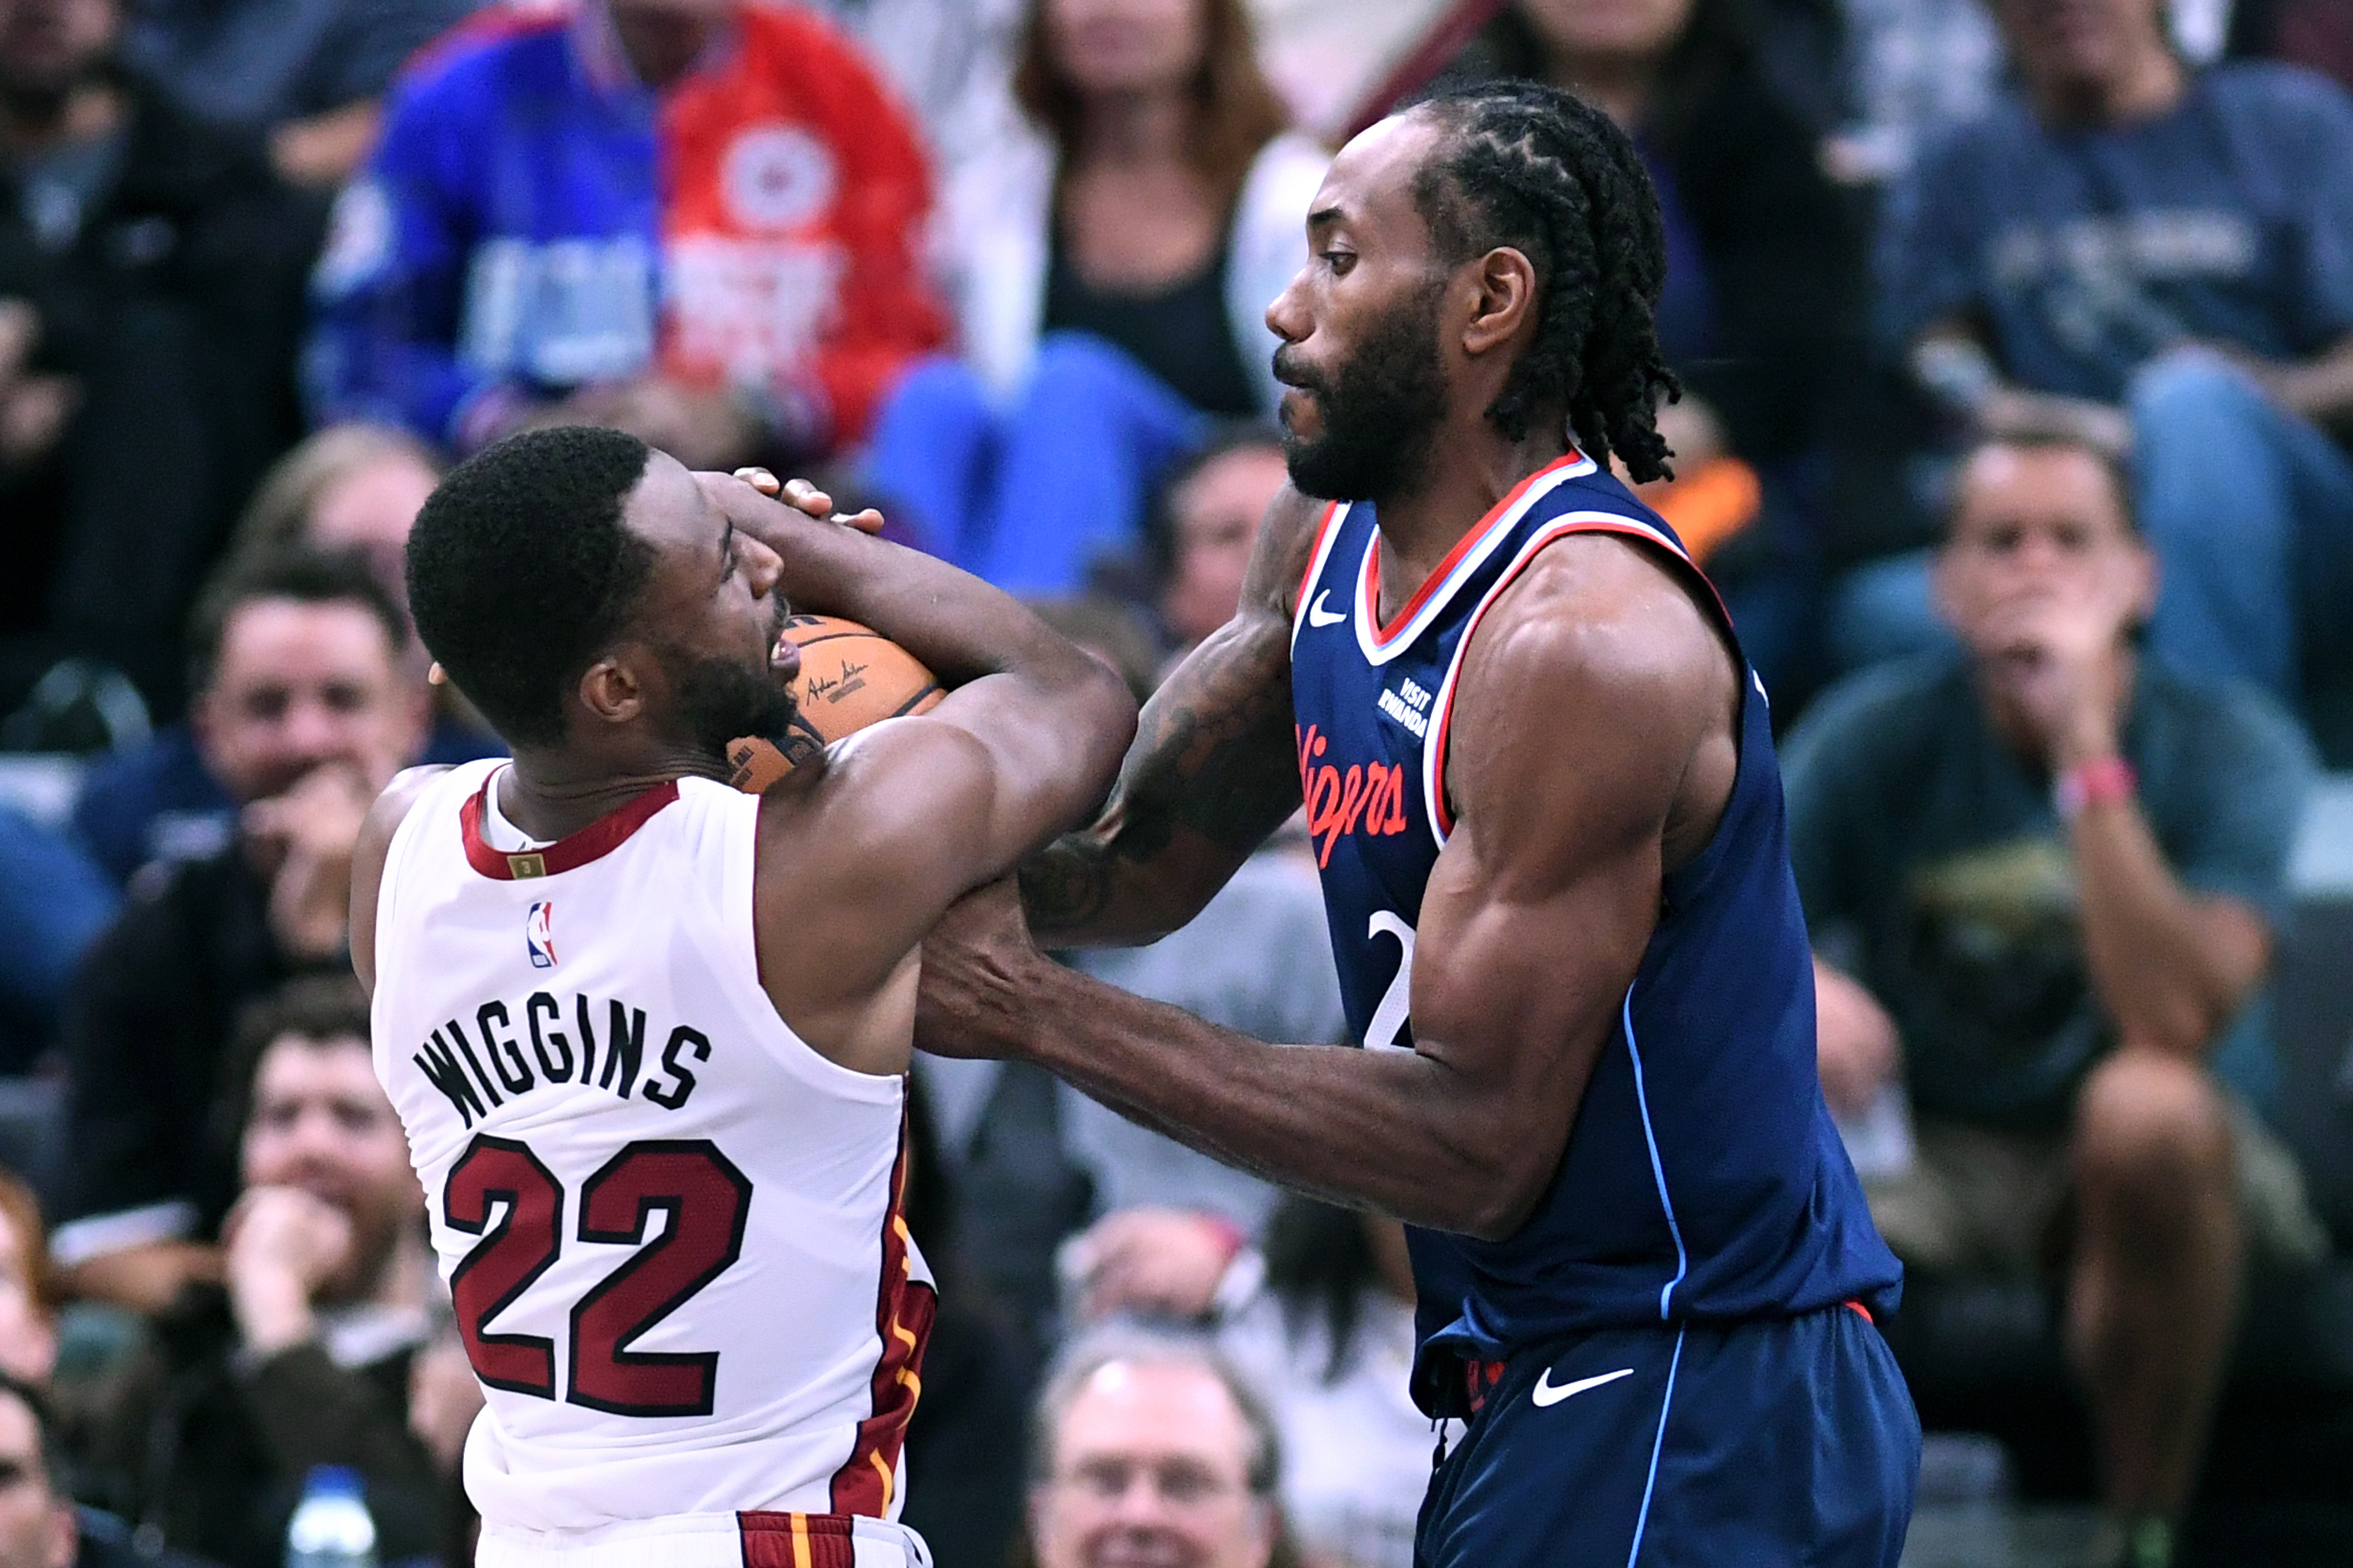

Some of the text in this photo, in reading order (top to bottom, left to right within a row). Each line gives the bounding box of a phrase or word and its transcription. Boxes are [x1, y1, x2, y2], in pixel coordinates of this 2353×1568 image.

[1377, 688, 1428, 738] RWANDA
[1399, 677, 1432, 711] VISIT
[1363, 909, 1417, 1051] 2
[412, 991, 712, 1130] WIGGINS
[444, 1132, 753, 1417] 22
